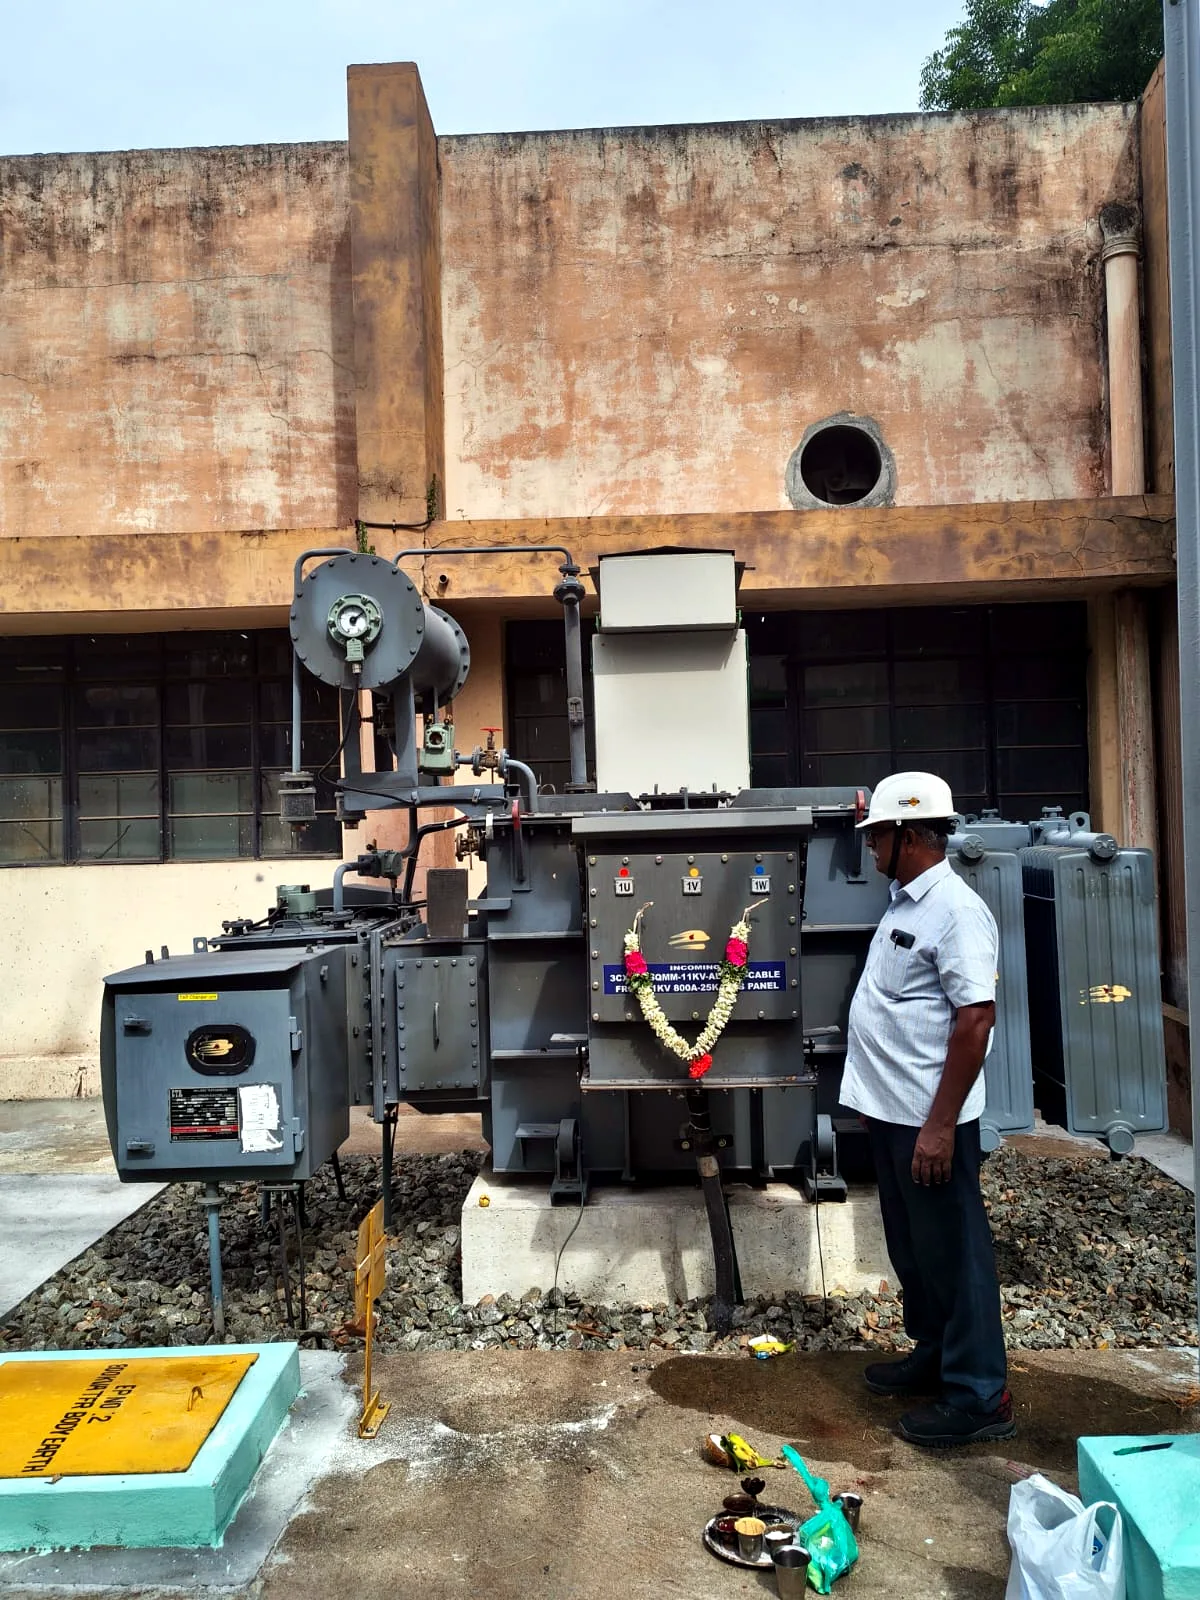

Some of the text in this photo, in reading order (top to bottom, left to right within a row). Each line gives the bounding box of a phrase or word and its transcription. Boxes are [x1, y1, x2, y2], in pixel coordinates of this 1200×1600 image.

[618, 881, 631, 892] 1U
[687, 881, 699, 891] 1V
[754, 880, 768, 890] 1W
[673, 983, 719, 992] 800A-25K
[747, 981, 780, 990] PANEL
[71, 1390, 104, 1409] TFR
[49, 1411, 87, 1435] BODY
[21, 1437, 67, 1472] EARTH
